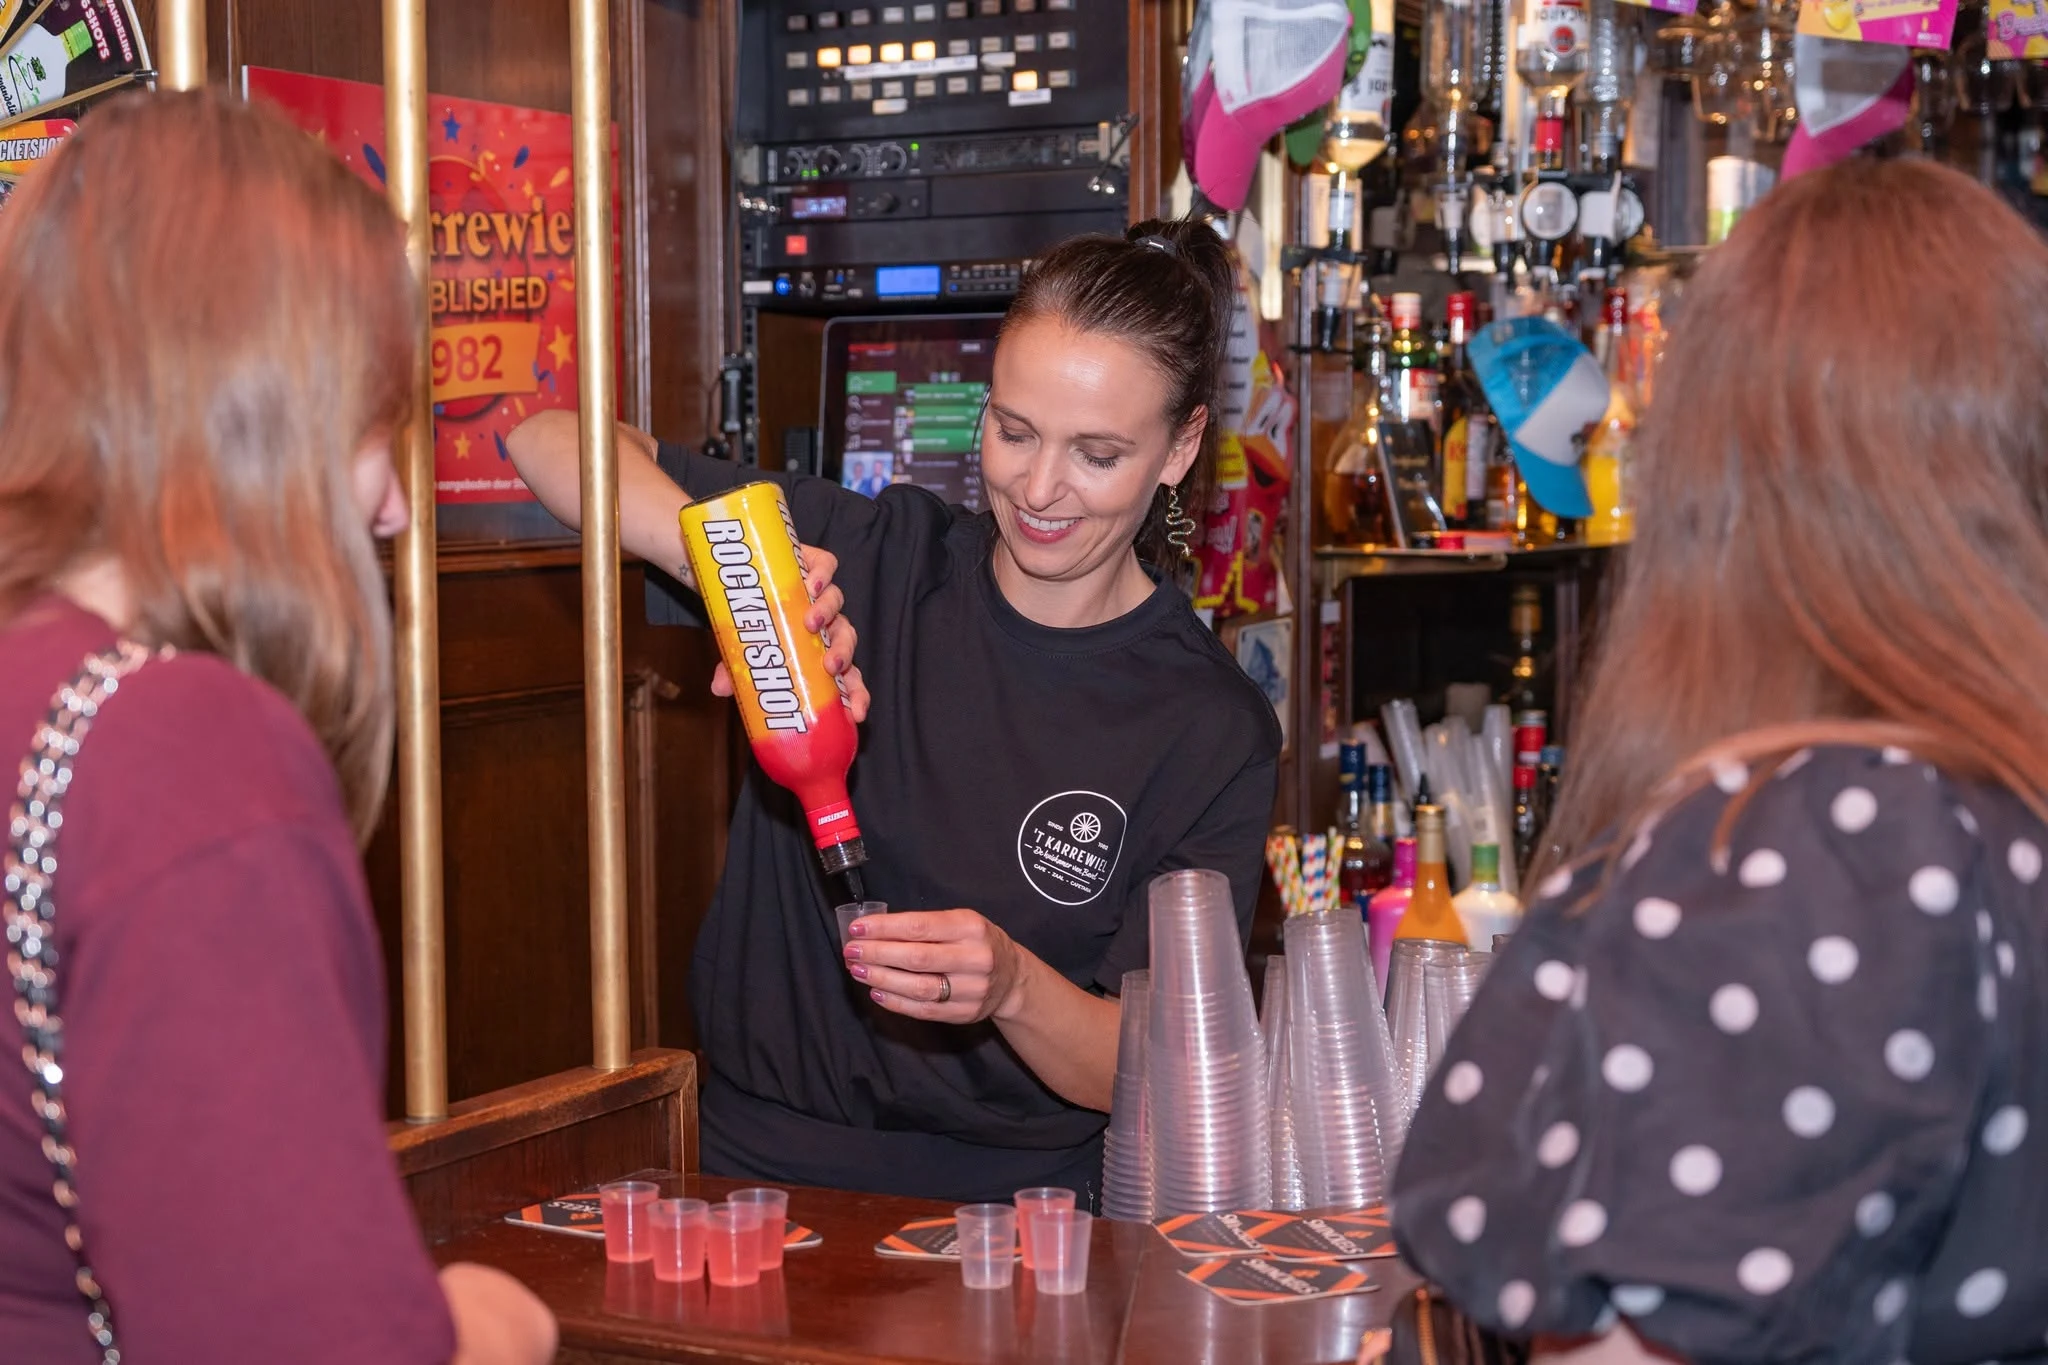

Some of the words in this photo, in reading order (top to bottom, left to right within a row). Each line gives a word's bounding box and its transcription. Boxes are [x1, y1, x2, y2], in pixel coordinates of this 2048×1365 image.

[85, 7, 110, 60] SHOTS
[432, 334, 504, 386] 982
[702, 519, 808, 733] ROCKETSHOT
[1034, 828, 1045, 843] 'T
[1045, 836, 1108, 873] KARREWIEL
[1051, 872, 1064, 882] ZAAL
